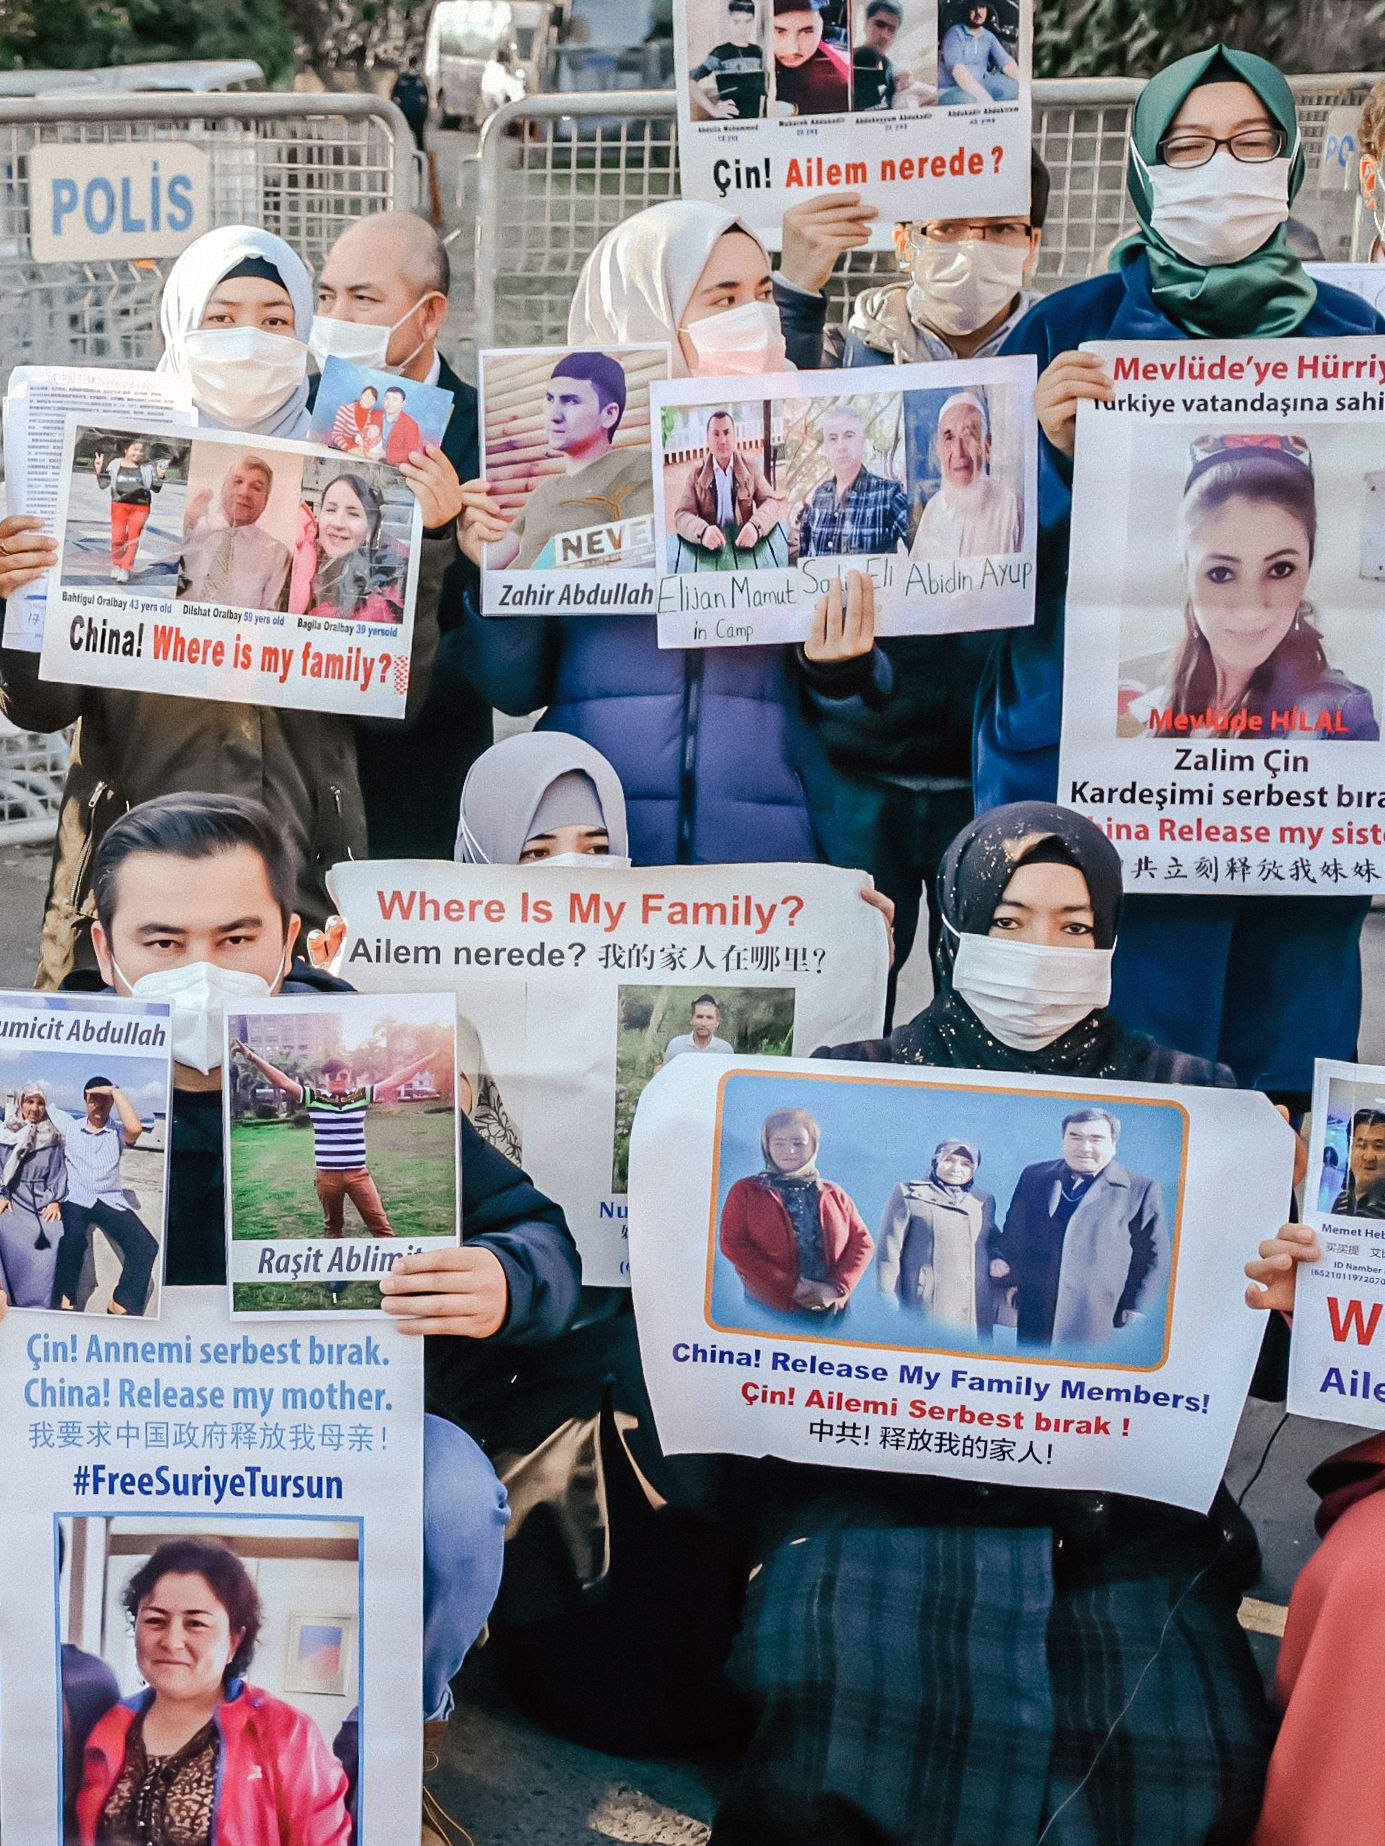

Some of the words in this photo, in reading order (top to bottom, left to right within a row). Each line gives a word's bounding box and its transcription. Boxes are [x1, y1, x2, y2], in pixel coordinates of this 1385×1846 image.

[714, 158, 770, 197] Çin!
[785, 156, 867, 188] Ailem
[52, 160, 195, 235] POLİS
[1182, 392, 1328, 416] vatandaşına
[732, 577, 796, 608] Mamut
[905, 560, 972, 596] Abidin
[980, 558, 1032, 589] Ayup
[62, 592, 95, 607] Bahtigul
[141, 602, 157, 613] yers
[160, 604, 172, 613] old
[499, 584, 554, 606] Zahir
[558, 581, 654, 606] Abdullah
[213, 609, 242, 622] Oralbay
[255, 614, 270, 626] yers
[273, 616, 284, 625] old
[694, 621, 707, 640] in
[717, 619, 753, 641] Camp
[69, 615, 143, 657] China!
[153, 625, 224, 670] Where
[233, 634, 251, 670] is
[261, 648, 293, 682] my
[302, 642, 391, 691] family?
[1271, 705, 1349, 732] HİLAL
[1174, 748, 1254, 771] Zalim
[1264, 750, 1309, 778] Çin
[1071, 781, 1213, 811] Kardeşimi
[1222, 784, 1327, 807] serbest
[1159, 818, 1270, 842] Release
[1279, 826, 1323, 850] my
[377, 891, 505, 921] Where
[522, 891, 552, 922] Is
[569, 893, 626, 932] My
[641, 893, 804, 934] Family?
[349, 938, 440, 964] Ailem
[453, 942, 586, 968] nerede?
[67, 1022, 165, 1047] Abdullah
[1322, 1224, 1361, 1236] Memet
[258, 1247, 323, 1280] Raşit
[27, 1334, 78, 1370] Çin!
[86, 1335, 193, 1364] Annemi
[200, 1337, 300, 1366] serbest
[309, 1341, 390, 1367] bırak.
[672, 1343, 761, 1369] China!
[771, 1351, 888, 1384] Release
[898, 1363, 942, 1392] My
[951, 1369, 1050, 1402] Family
[1061, 1378, 1211, 1414] Members!
[24, 1379, 110, 1407] China!
[119, 1379, 224, 1409] Release
[233, 1389, 271, 1417] my
[283, 1384, 393, 1412] mother.
[741, 1381, 795, 1407] Çin!
[805, 1389, 897, 1417] Ailemi
[909, 1399, 1023, 1431] Serbest
[1035, 1410, 1110, 1435] bırak
[74, 1465, 343, 1504] #FreeSuriyeTursun
